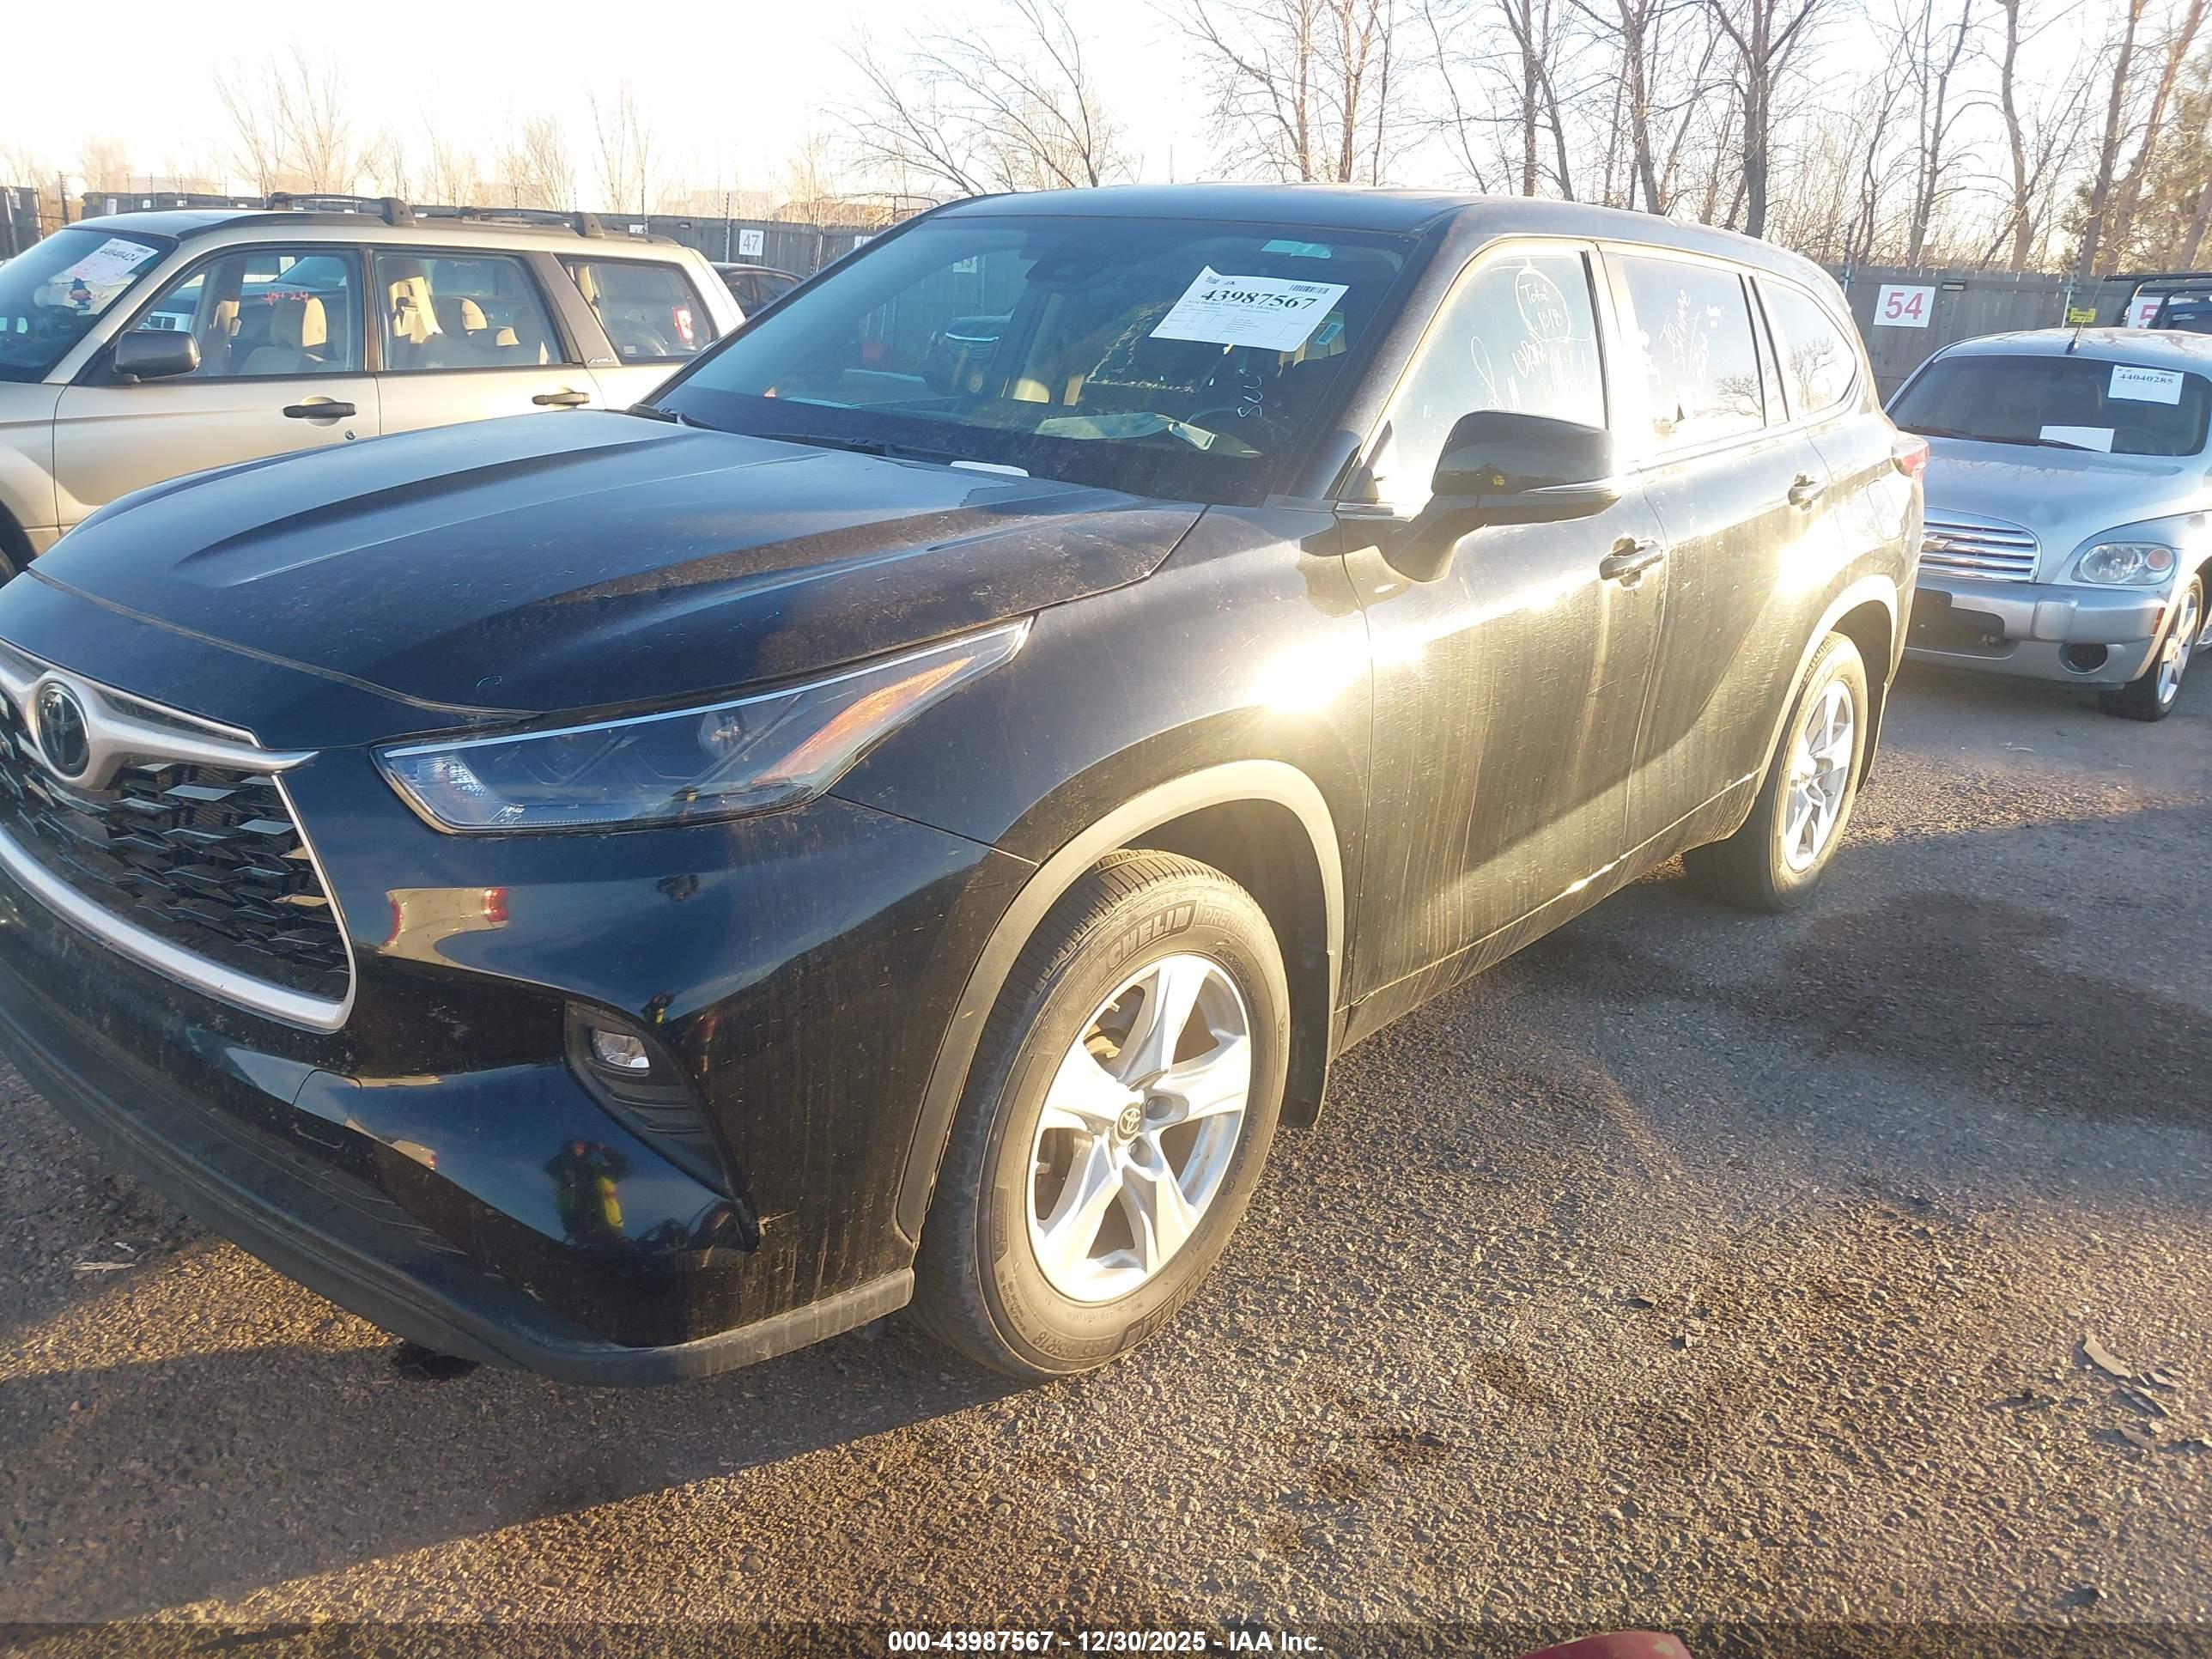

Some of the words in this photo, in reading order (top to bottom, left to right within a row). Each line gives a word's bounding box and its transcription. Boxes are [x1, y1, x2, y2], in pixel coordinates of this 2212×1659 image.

[743, 233, 760, 252] 47
[1200, 289, 1320, 310] 43987567
[1884, 291, 1923, 320] 54
[1084, 905, 1192, 989] ICHELIN
